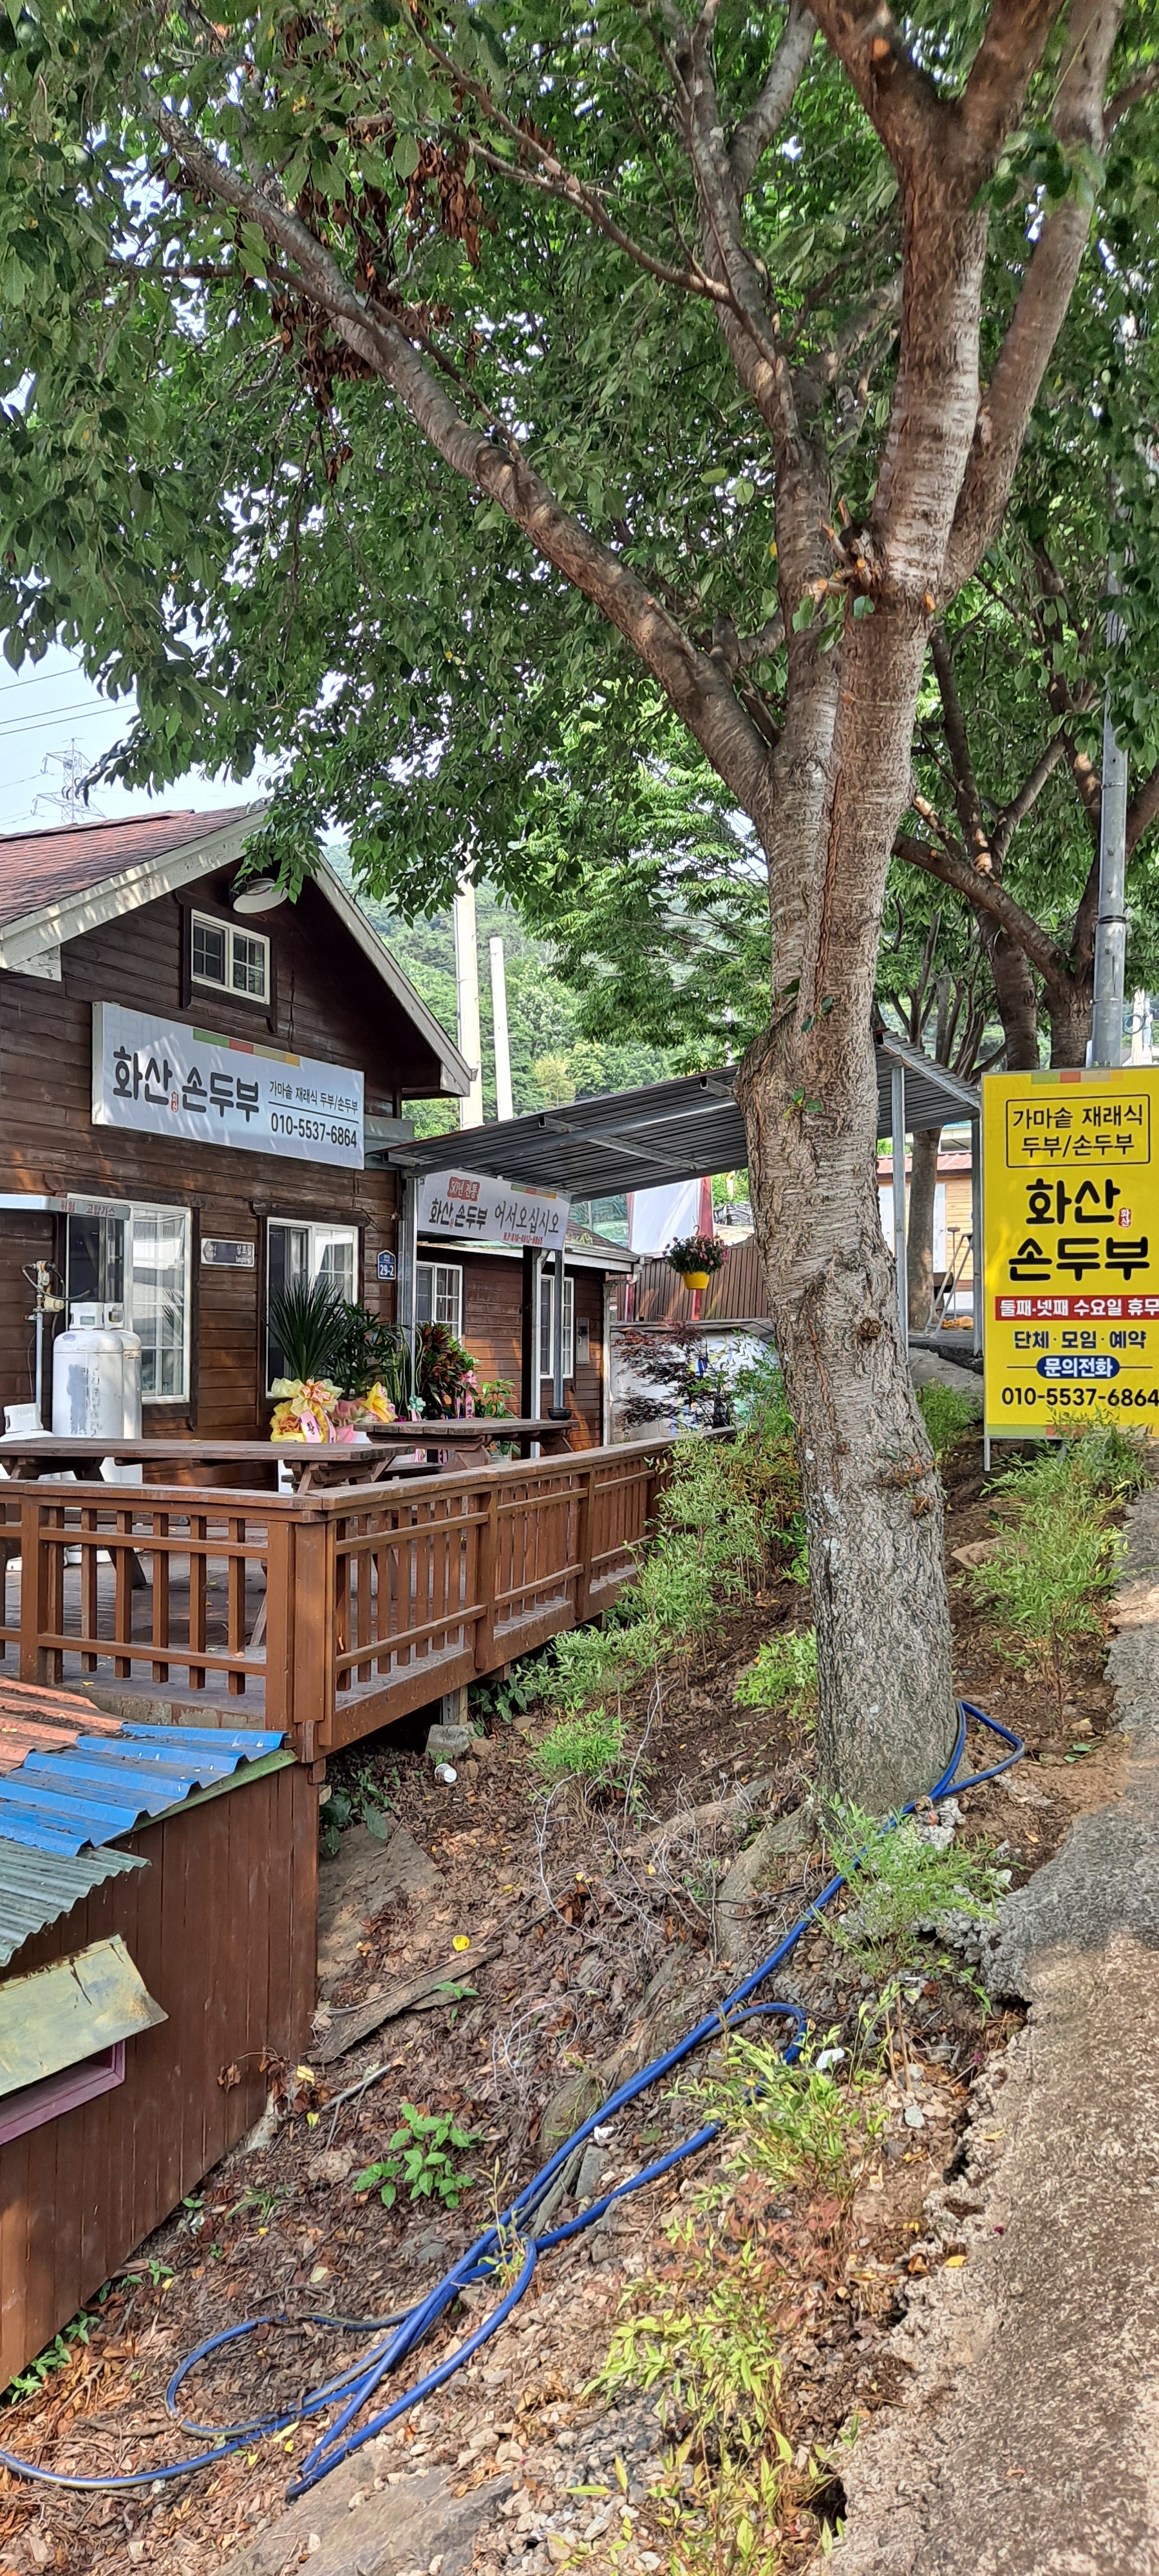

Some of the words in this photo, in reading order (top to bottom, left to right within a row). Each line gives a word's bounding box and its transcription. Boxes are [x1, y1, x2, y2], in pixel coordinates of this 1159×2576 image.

[113, 1045, 173, 1105] 화산
[182, 1066, 259, 1122] 손두부
[269, 1080, 292, 1100] 가마솥
[296, 1086, 317, 1106] 재래식
[320, 1092, 358, 1115] 두부/손두부
[271, 1112, 357, 1148] 010-5537-6864
[1012, 1106, 1073, 1130] 가마솥
[1082, 1104, 1142, 1127] 재래식
[1021, 1133, 1135, 1158] 두부/손두부
[1026, 1178, 1121, 1225] 화산
[428, 1198, 453, 1226] 화산
[455, 1204, 488, 1231] 손두부
[495, 1200, 559, 1236] 어서오십시오
[380, 1264, 394, 1276] 29-2
[1008, 1236, 1150, 1281] 손두부
[1073, 1298, 1122, 1316] 수요일
[1127, 1298, 1159, 1316] 휴무
[1014, 1331, 1049, 1349] 단체
[1061, 1331, 1097, 1349] 모임
[1109, 1331, 1146, 1349] 예약
[1044, 1358, 1113, 1378] 문의전화
[1001, 1387, 1159, 1406] 010-5537-6864
